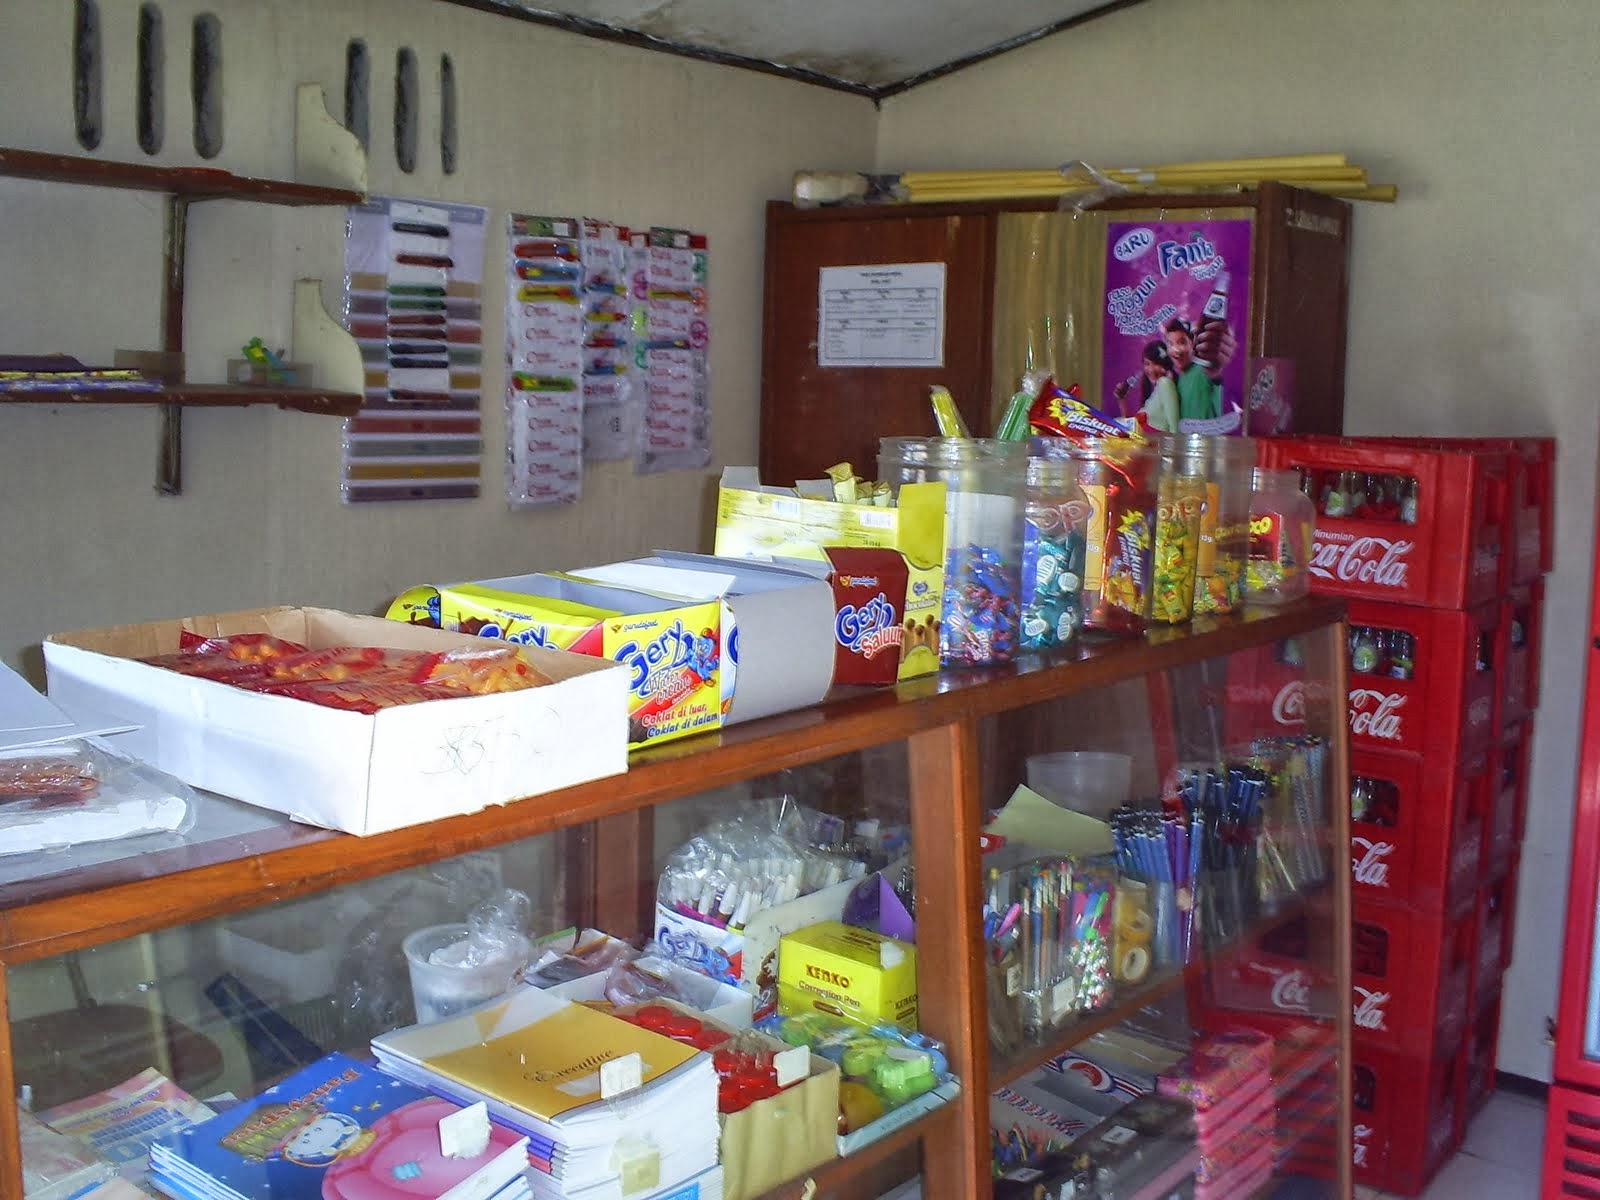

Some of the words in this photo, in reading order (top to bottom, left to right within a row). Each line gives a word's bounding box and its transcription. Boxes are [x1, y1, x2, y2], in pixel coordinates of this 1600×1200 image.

[1115, 232, 1151, 258] BARU
[1157, 237, 1217, 278] Fanta
[1108, 275, 1157, 315] anggur
[1065, 410, 1122, 436] Biskuat
[835, 592, 896, 652] Gery
[613, 618, 696, 698] Gery
[641, 711, 676, 727] Coklat
[678, 706, 687, 718] di
[647, 718, 679, 738] Coklat
[681, 719, 691, 731] di
[693, 713, 719, 727] dalam
[806, 964, 850, 989] KENKO
[798, 980, 842, 1001] Correction
[844, 995, 861, 1007] Pen
